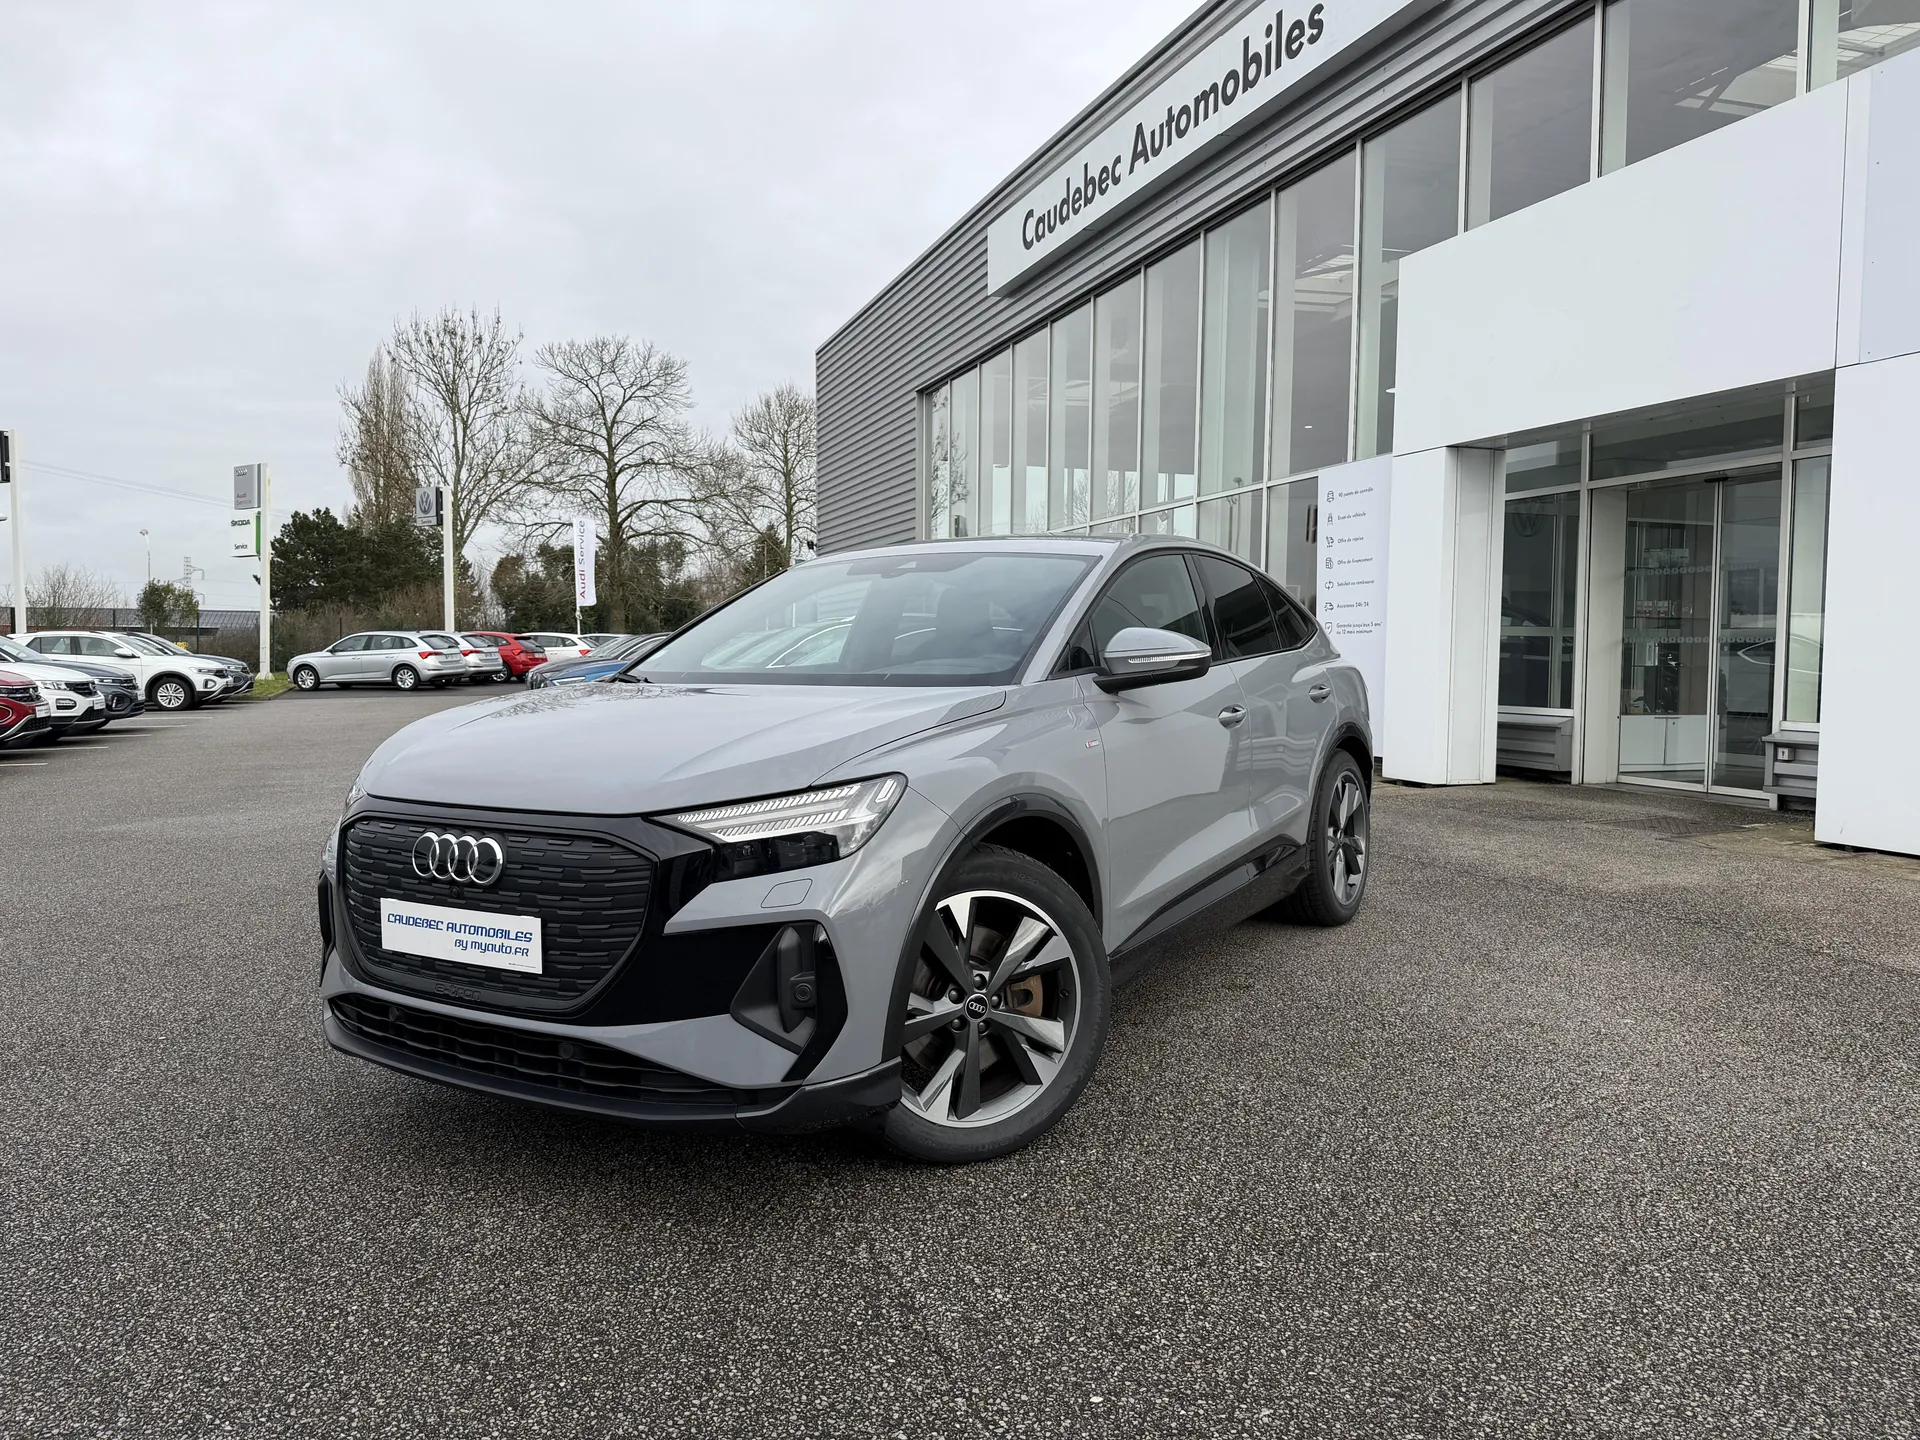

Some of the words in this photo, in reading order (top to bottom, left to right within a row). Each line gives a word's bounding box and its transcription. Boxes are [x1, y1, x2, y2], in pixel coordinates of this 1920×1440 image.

[1022, 154, 1122, 251] Caudebec
[1128, 2, 1325, 176] Automobiles
[578, 520, 586, 565] Service
[387, 913, 444, 931] CAUDEBEC
[446, 922, 533, 943] AUTOMOBILES
[435, 983, 481, 1001] e-tron
